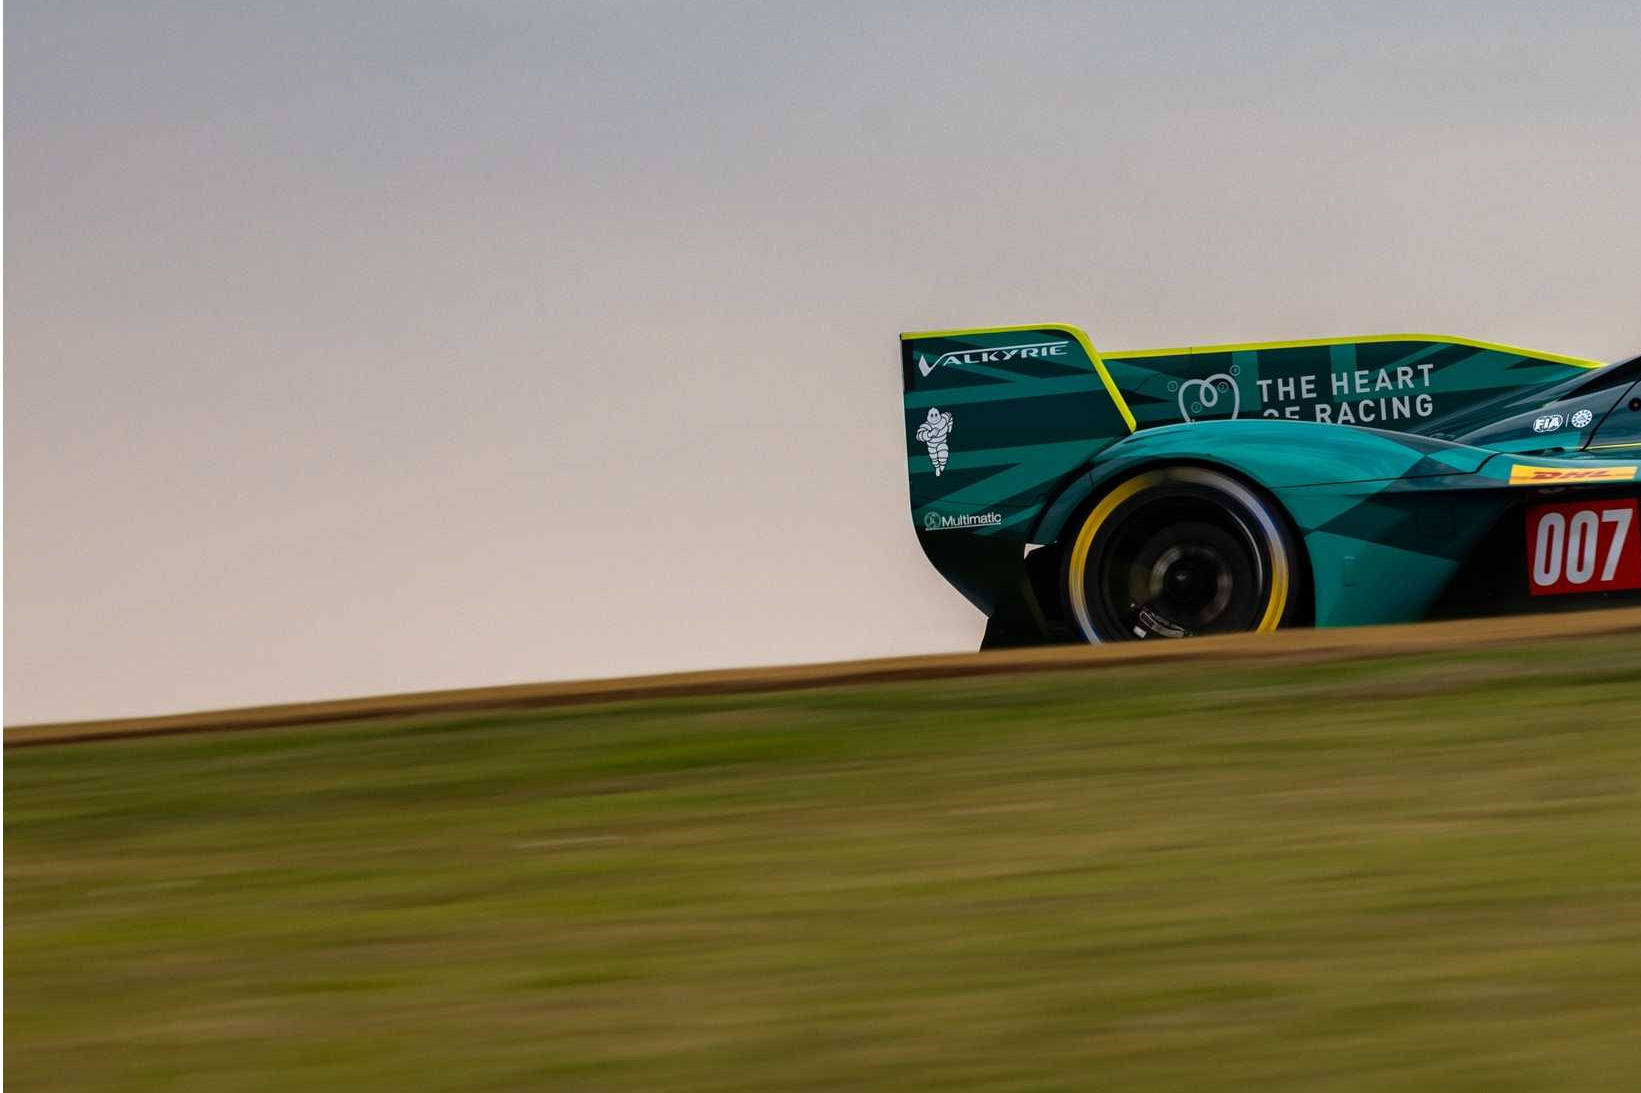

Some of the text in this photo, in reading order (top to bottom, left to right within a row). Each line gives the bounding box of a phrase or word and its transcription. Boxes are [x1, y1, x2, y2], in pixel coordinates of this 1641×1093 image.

[918, 341, 1069, 378] VALKYRIE
[1257, 364, 1434, 403] THE HEART
[1315, 394, 1433, 425] RACING
[1534, 416, 1560, 430] FIA
[941, 512, 1001, 527] Multimatic
[1533, 508, 1633, 587] 007
